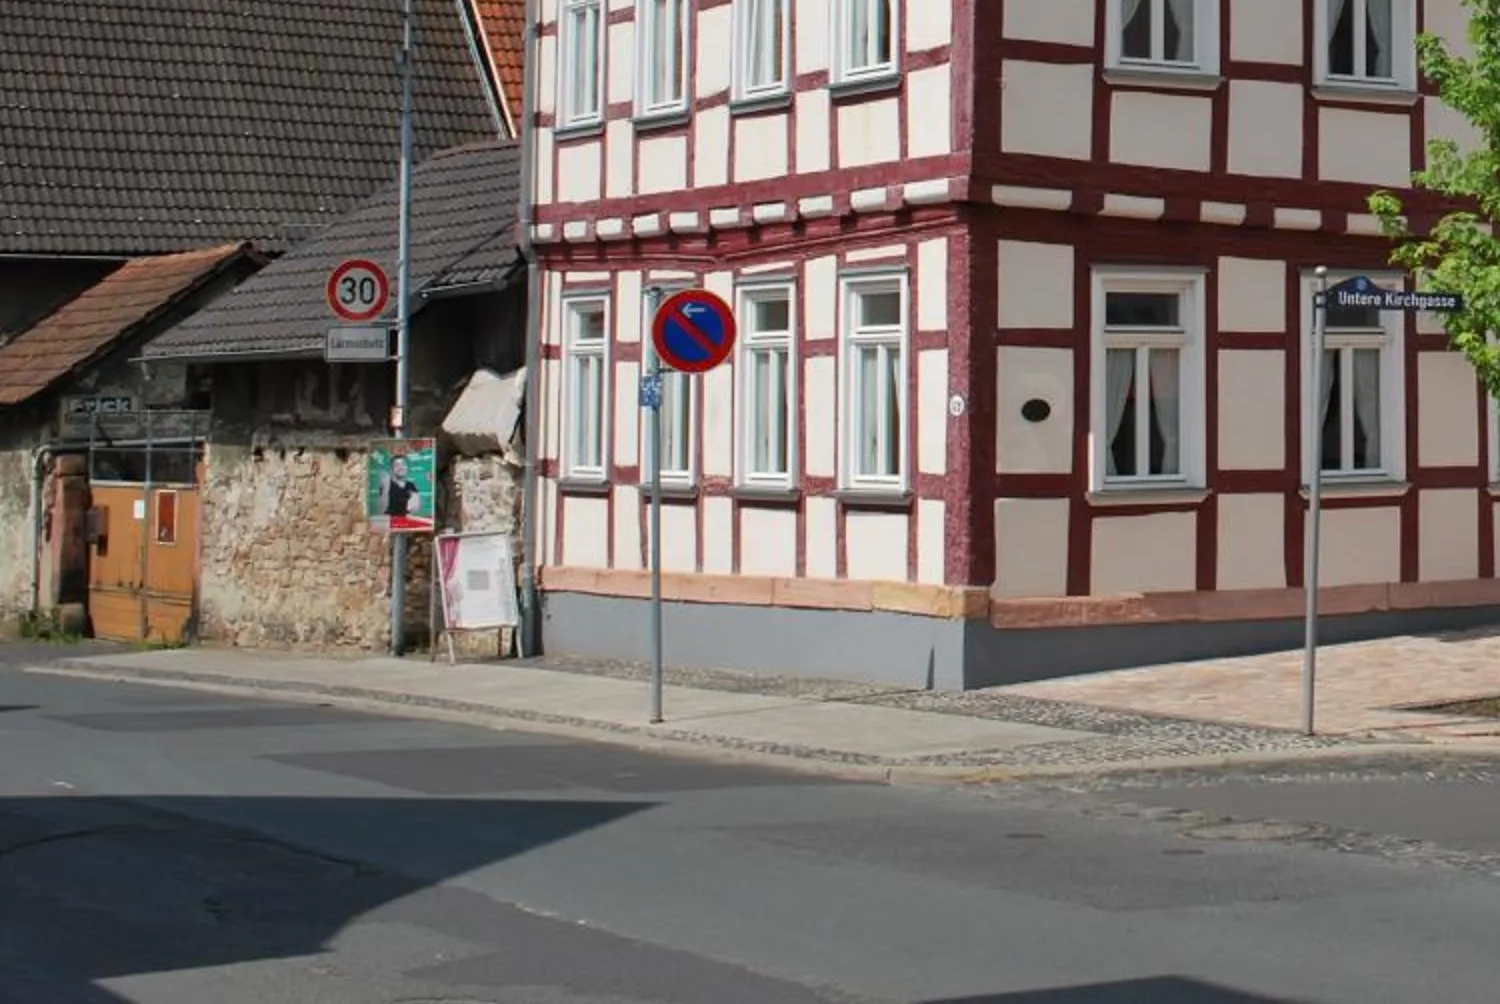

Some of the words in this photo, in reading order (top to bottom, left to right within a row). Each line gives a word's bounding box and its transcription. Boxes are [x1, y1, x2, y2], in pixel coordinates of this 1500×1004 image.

[340, 276, 375, 305] 30
[1338, 291, 1381, 306] Untere
[1385, 291, 1457, 308] Kirchgasse
